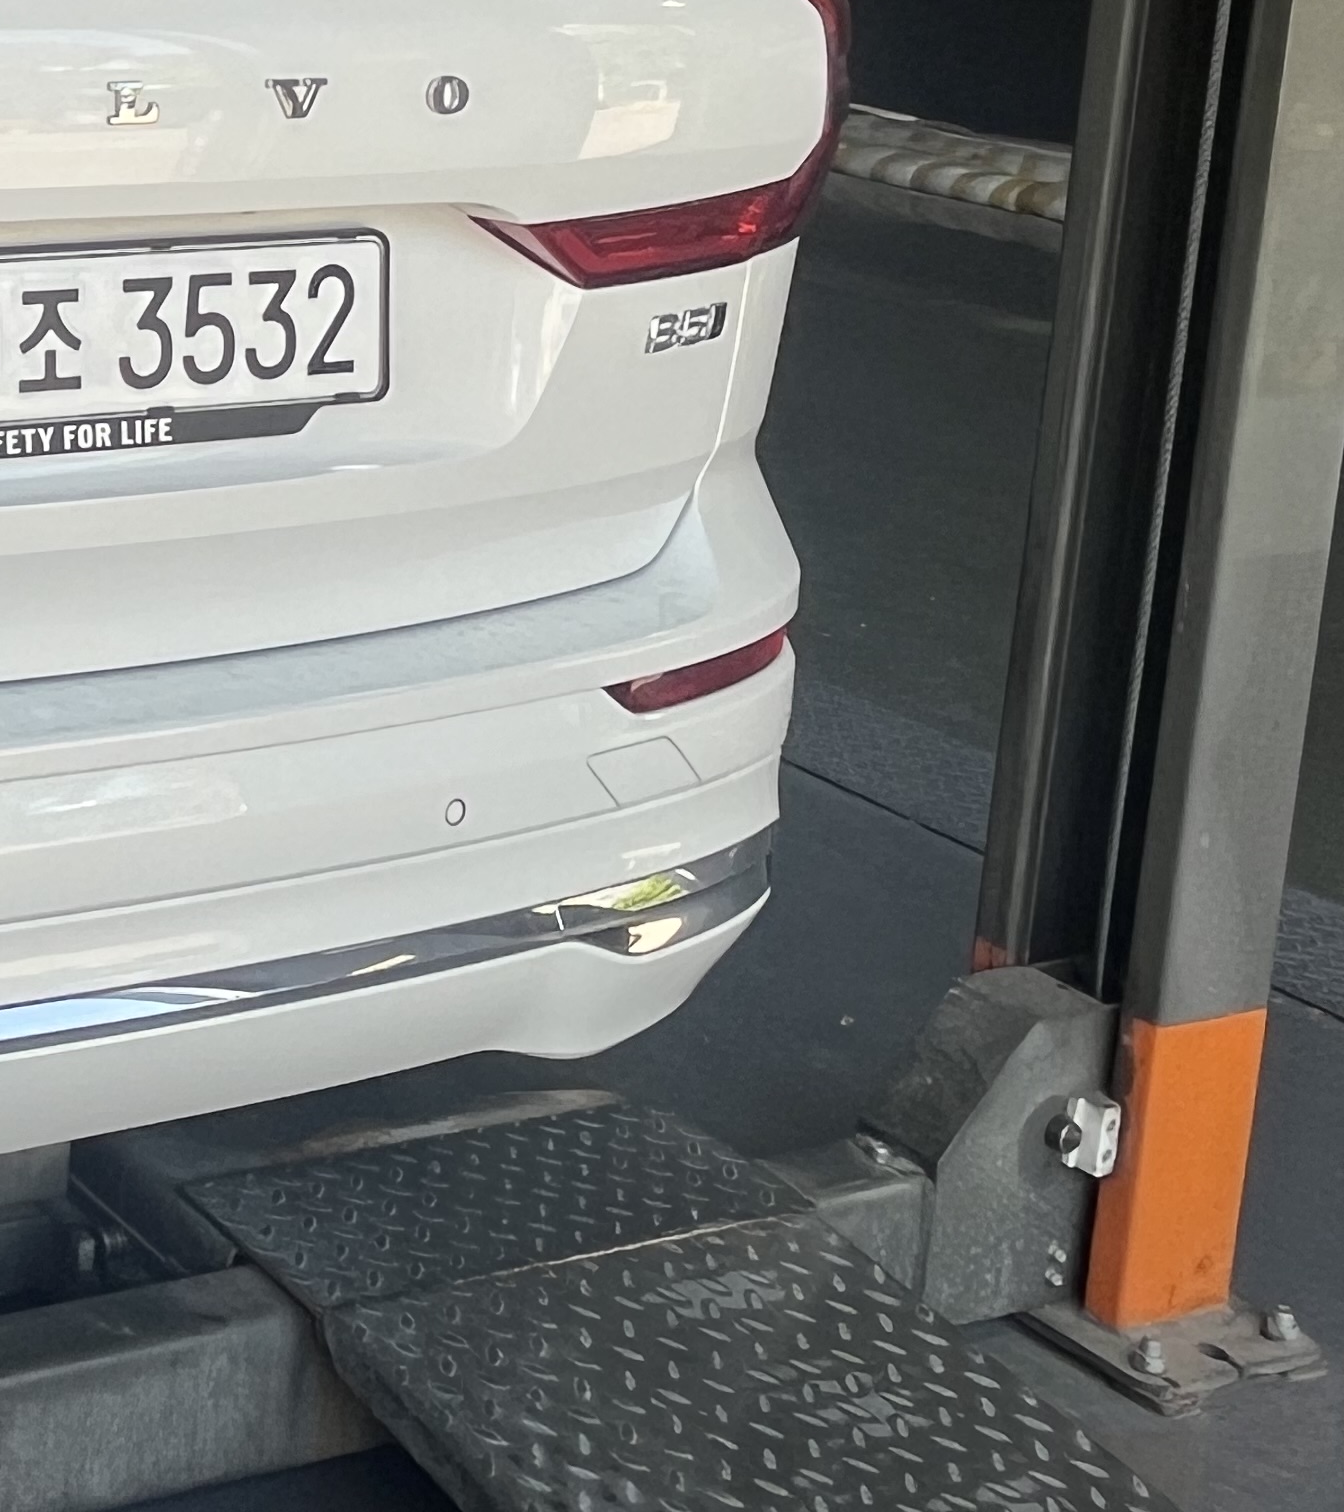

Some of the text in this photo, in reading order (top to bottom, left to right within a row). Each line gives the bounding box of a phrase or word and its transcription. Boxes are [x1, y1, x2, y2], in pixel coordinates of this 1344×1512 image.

[118, 263, 356, 392] 3532
[63, 422, 112, 451] FOR
[120, 417, 173, 446] LIFE
